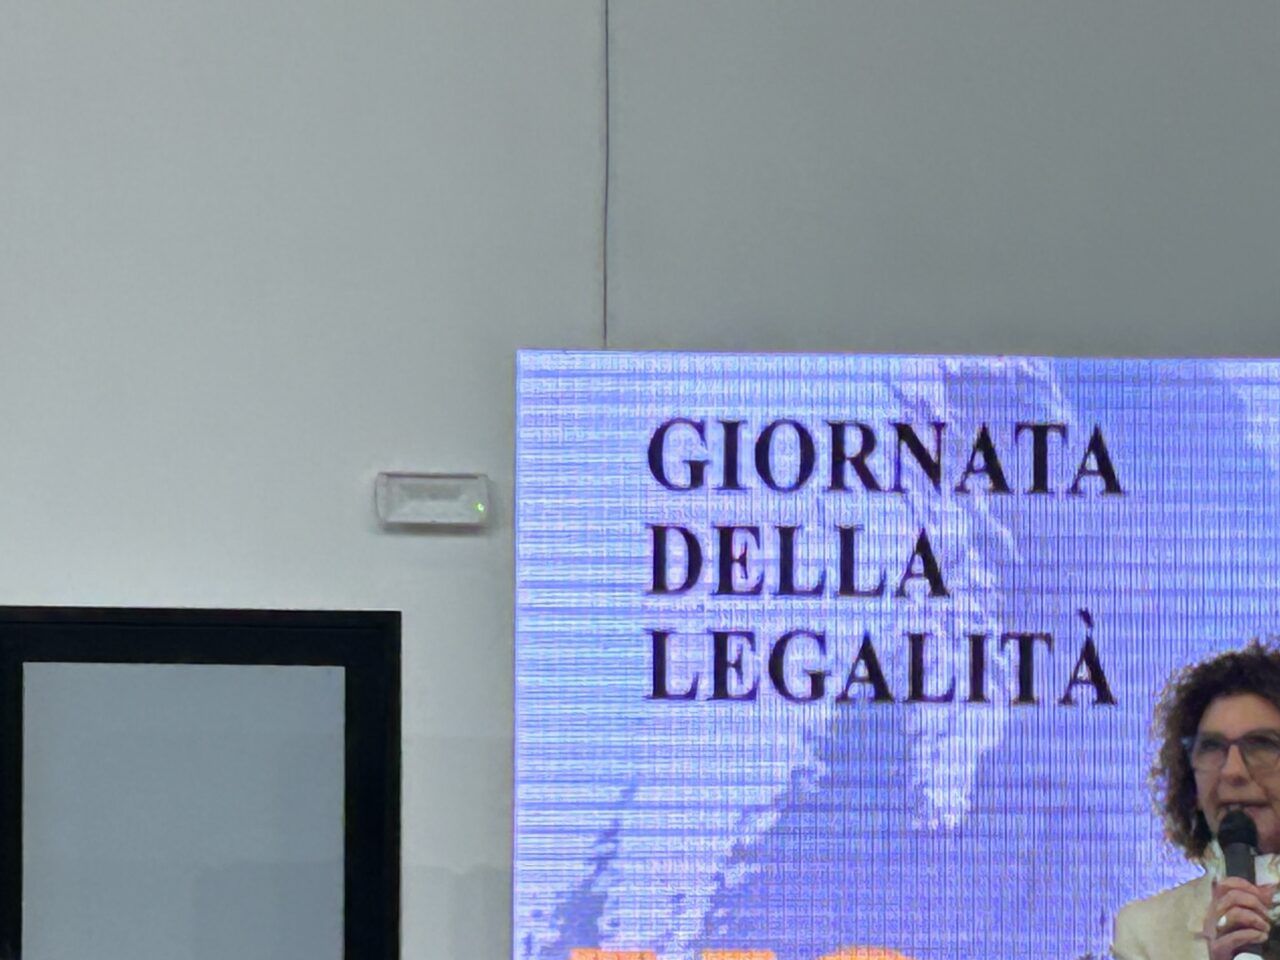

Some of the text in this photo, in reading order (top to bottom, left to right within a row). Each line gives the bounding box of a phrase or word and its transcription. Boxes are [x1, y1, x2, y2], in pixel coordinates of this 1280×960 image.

[647, 417, 1126, 496] GIORNATA
[647, 524, 950, 598] DELLA
[646, 609, 1117, 705] LEGALITÀ
